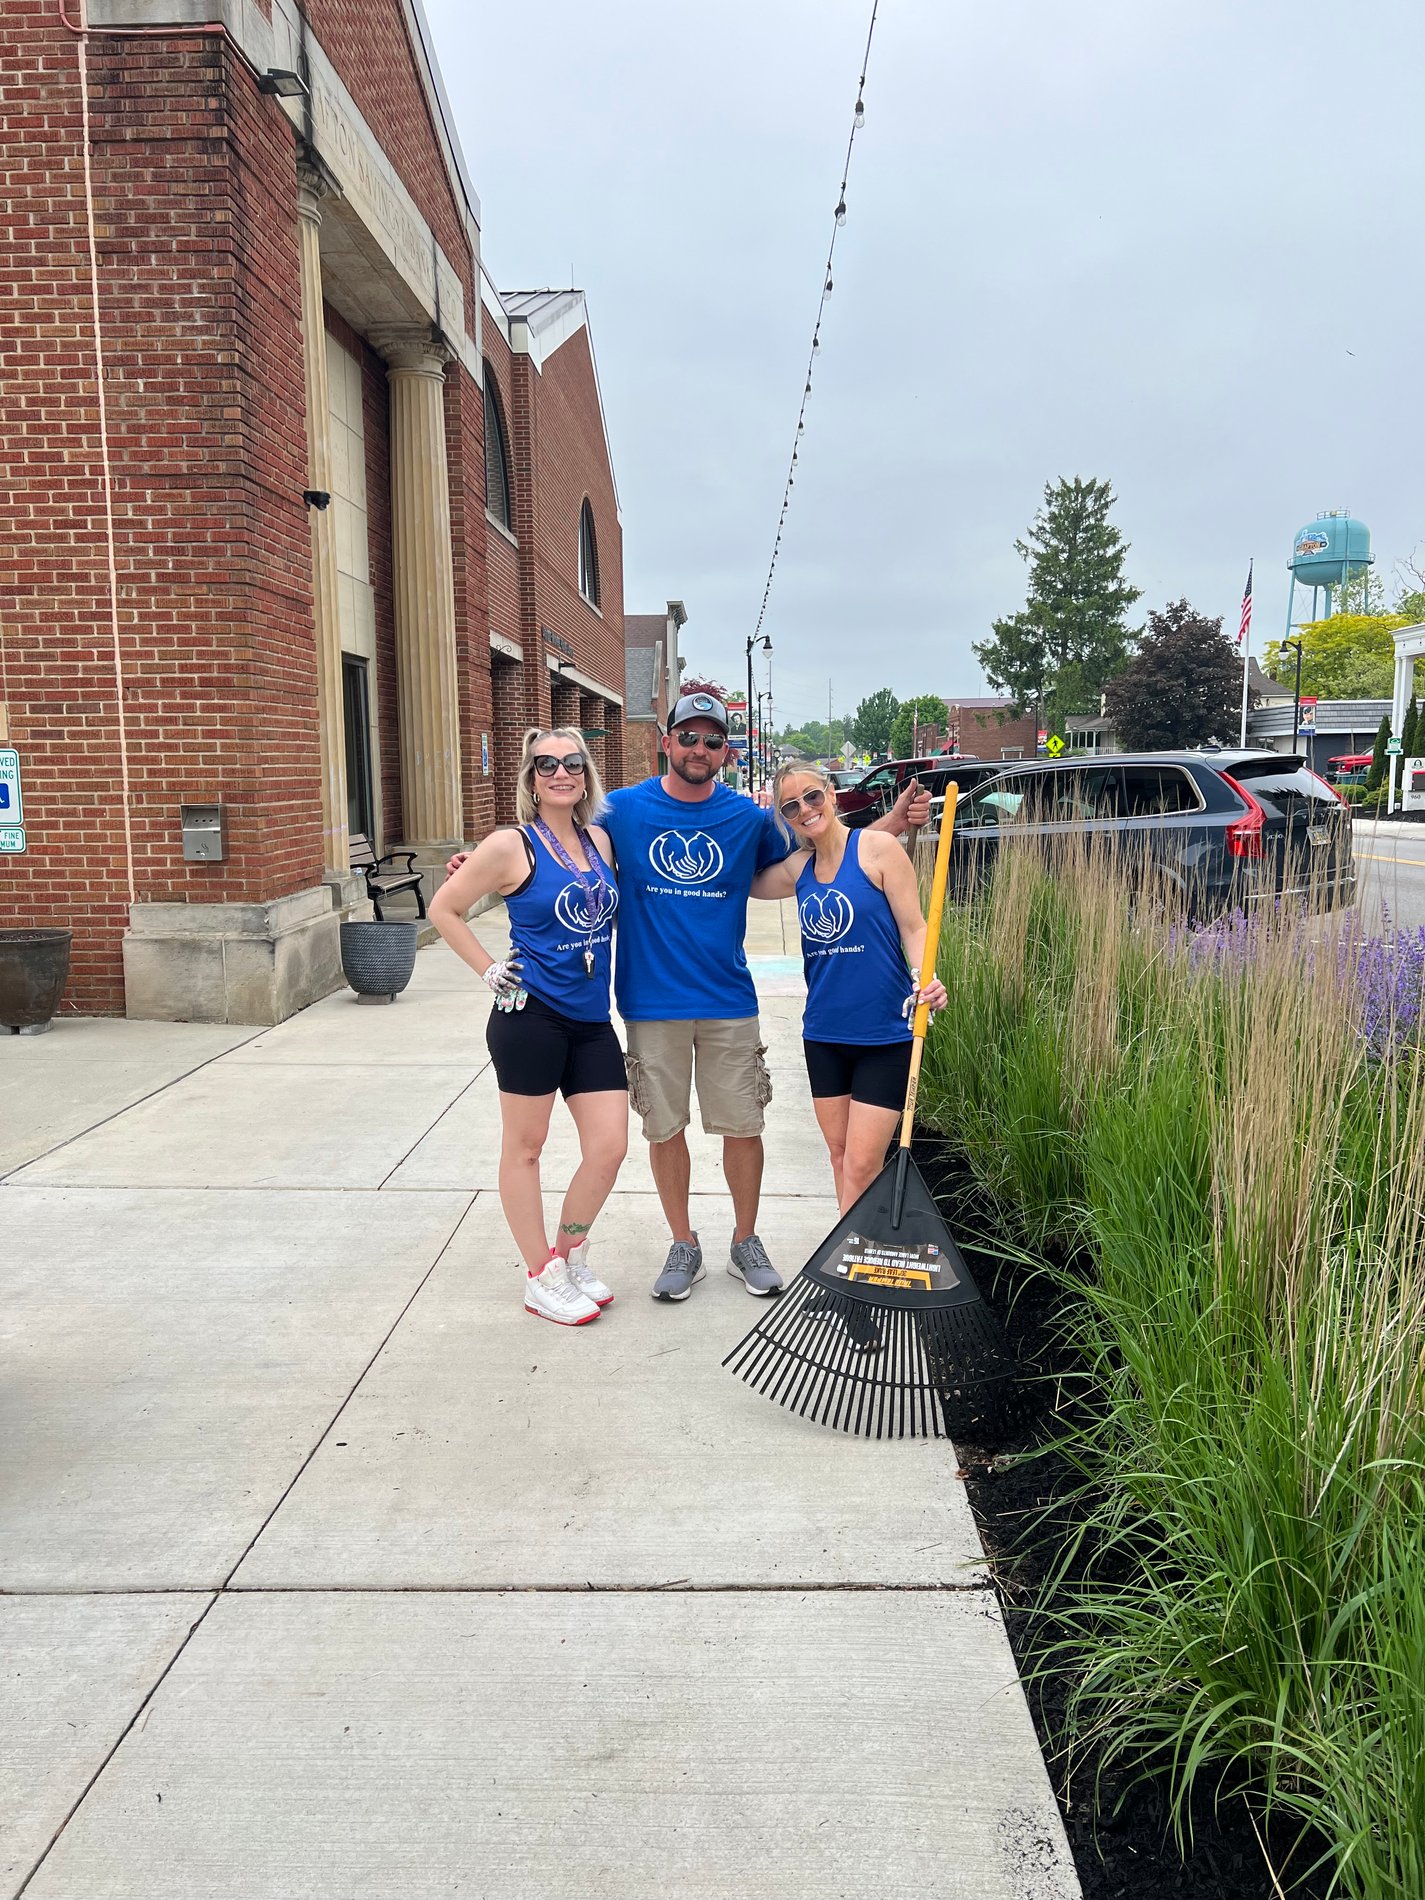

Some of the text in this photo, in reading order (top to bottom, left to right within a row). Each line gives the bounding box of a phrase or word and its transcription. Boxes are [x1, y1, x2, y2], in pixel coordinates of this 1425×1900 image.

[4, 832, 20, 840] FINE
[646, 885, 659, 893] Are
[702, 890, 727, 898] hands?
[570, 941, 582, 951] you
[806, 951, 818, 959] Are
[839, 944, 865, 953] hands?
[842, 1253, 941, 1273] LIGHTWEIGHT HEAD TO REDUCE FATIGUE
